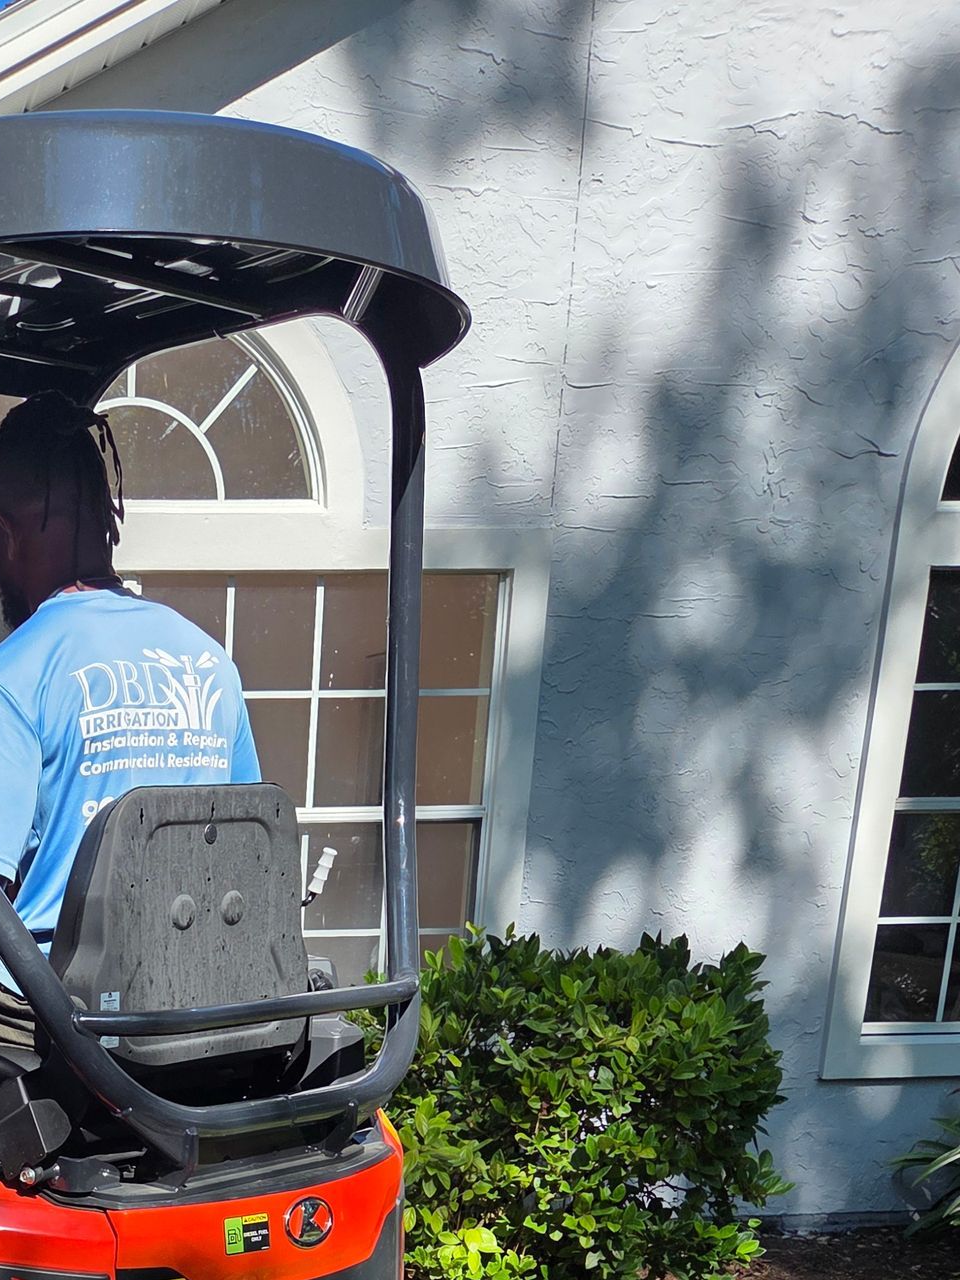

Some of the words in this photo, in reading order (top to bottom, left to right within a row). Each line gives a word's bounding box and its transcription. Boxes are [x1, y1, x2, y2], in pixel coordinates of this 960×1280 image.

[69, 660, 177, 714] DBD
[85, 711, 180, 735] IRRIGATION
[167, 733, 178, 747] &
